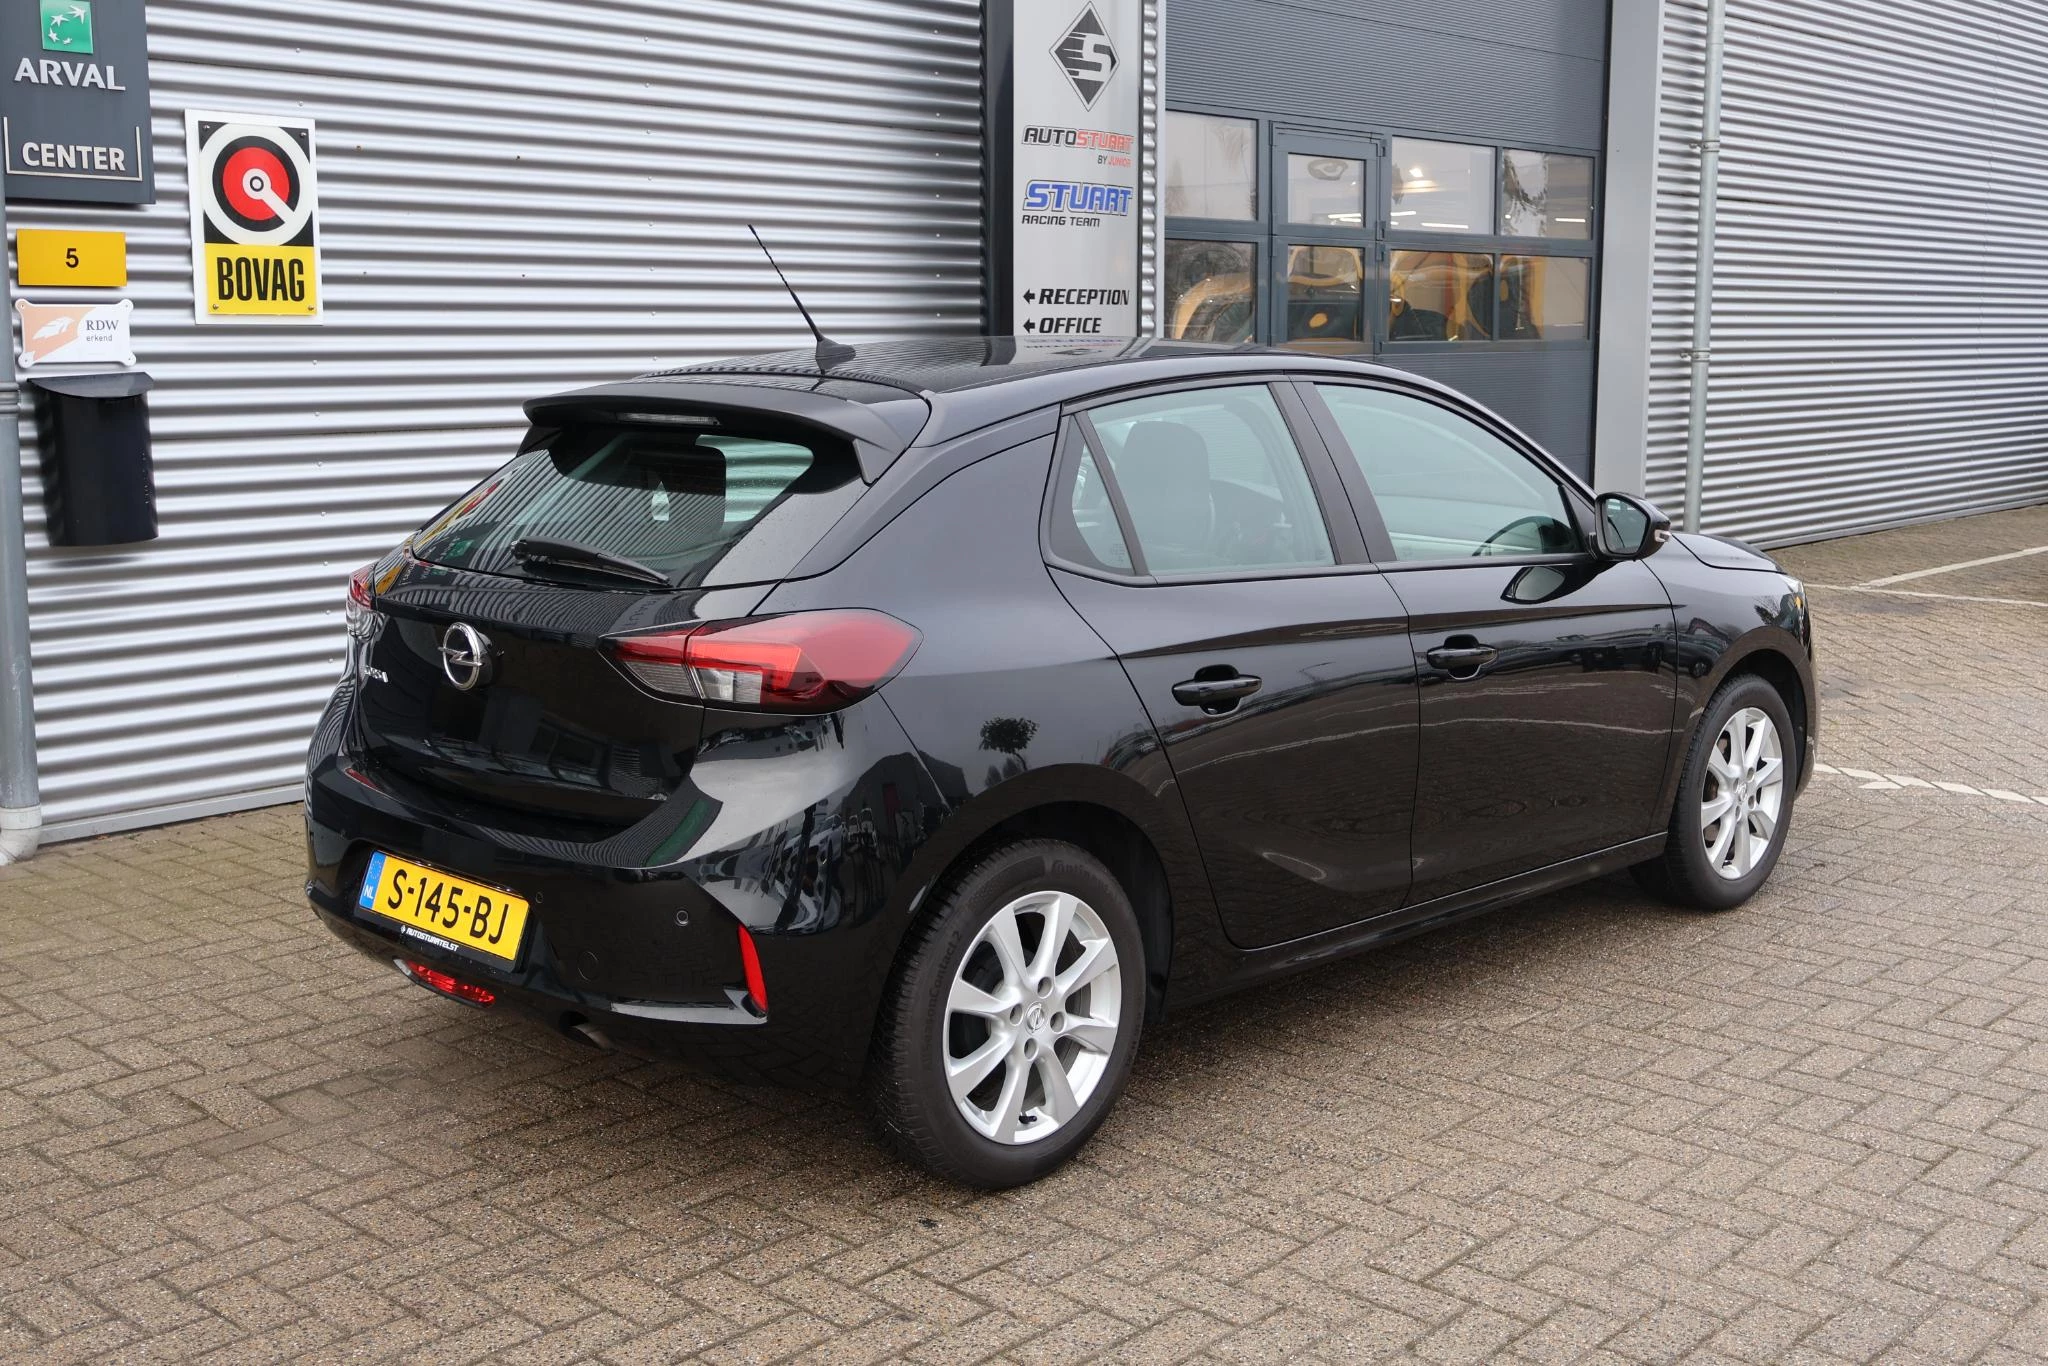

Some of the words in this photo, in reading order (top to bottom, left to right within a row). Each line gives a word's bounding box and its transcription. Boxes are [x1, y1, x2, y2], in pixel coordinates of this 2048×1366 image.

[14, 57, 126, 91] ARVAL
[1023, 126, 1133, 153] AUTOSTUART
[22, 141, 126, 171] CENTER
[1097, 155, 1107, 165] BY
[1024, 181, 1133, 215] STUART
[1021, 214, 1066, 225] RACING
[1069, 216, 1101, 228] TEAM
[65, 248, 79, 268] 5
[216, 256, 305, 302] BOVAG
[1038, 288, 1130, 305] RECEPTION
[86, 319, 119, 331] RDW
[1038, 317, 1102, 334] OFFICE
[86, 334, 113, 342] erkend
[363, 884, 374, 899] NL
[387, 869, 509, 944] S-145-BJ
